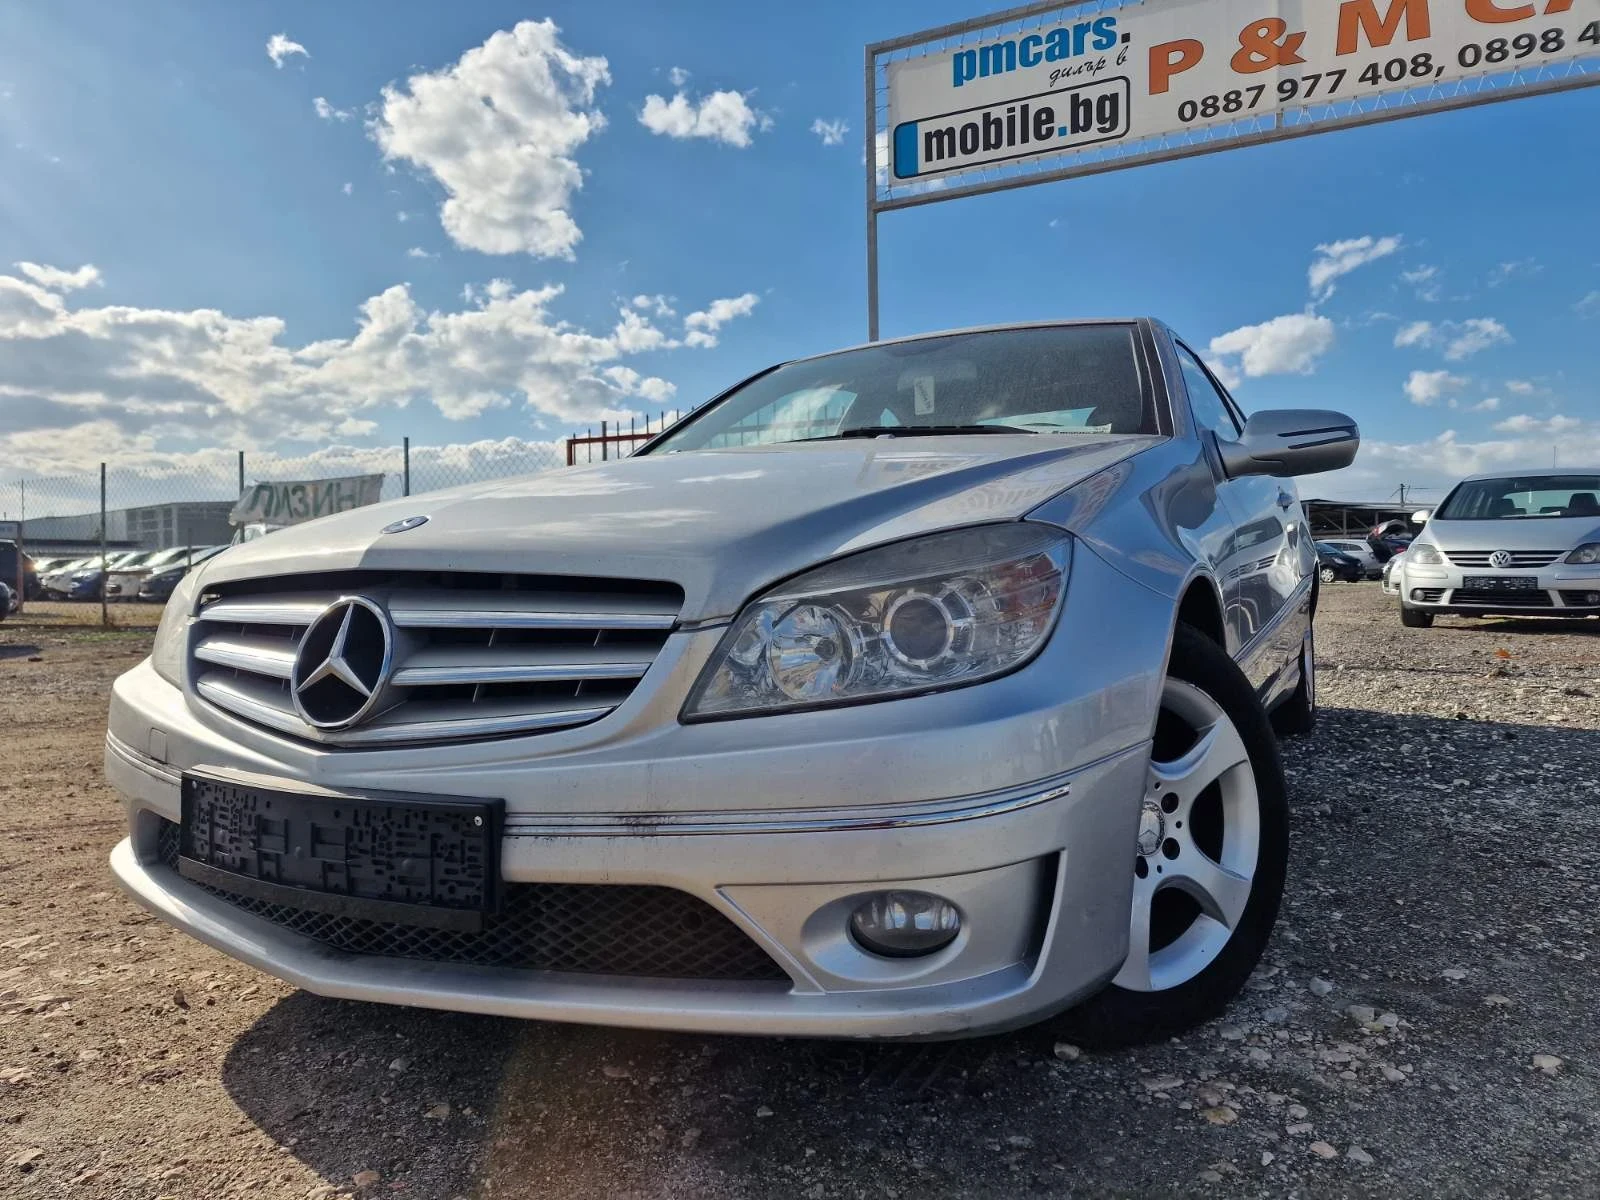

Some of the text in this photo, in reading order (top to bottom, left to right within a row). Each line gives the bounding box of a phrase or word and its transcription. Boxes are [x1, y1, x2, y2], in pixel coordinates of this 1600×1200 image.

[1049, 56, 1106, 87] дилър
[1149, 38, 1205, 96] P
[1230, 17, 1307, 74] &
[1335, 0, 1431, 56] M
[1178, 84, 1266, 122] 0887
[1277, 69, 1347, 102] 977
[1358, 52, 1445, 86] 408,
[1458, 27, 1566, 68] 0898
[924, 91, 1119, 163] mobile.bg
